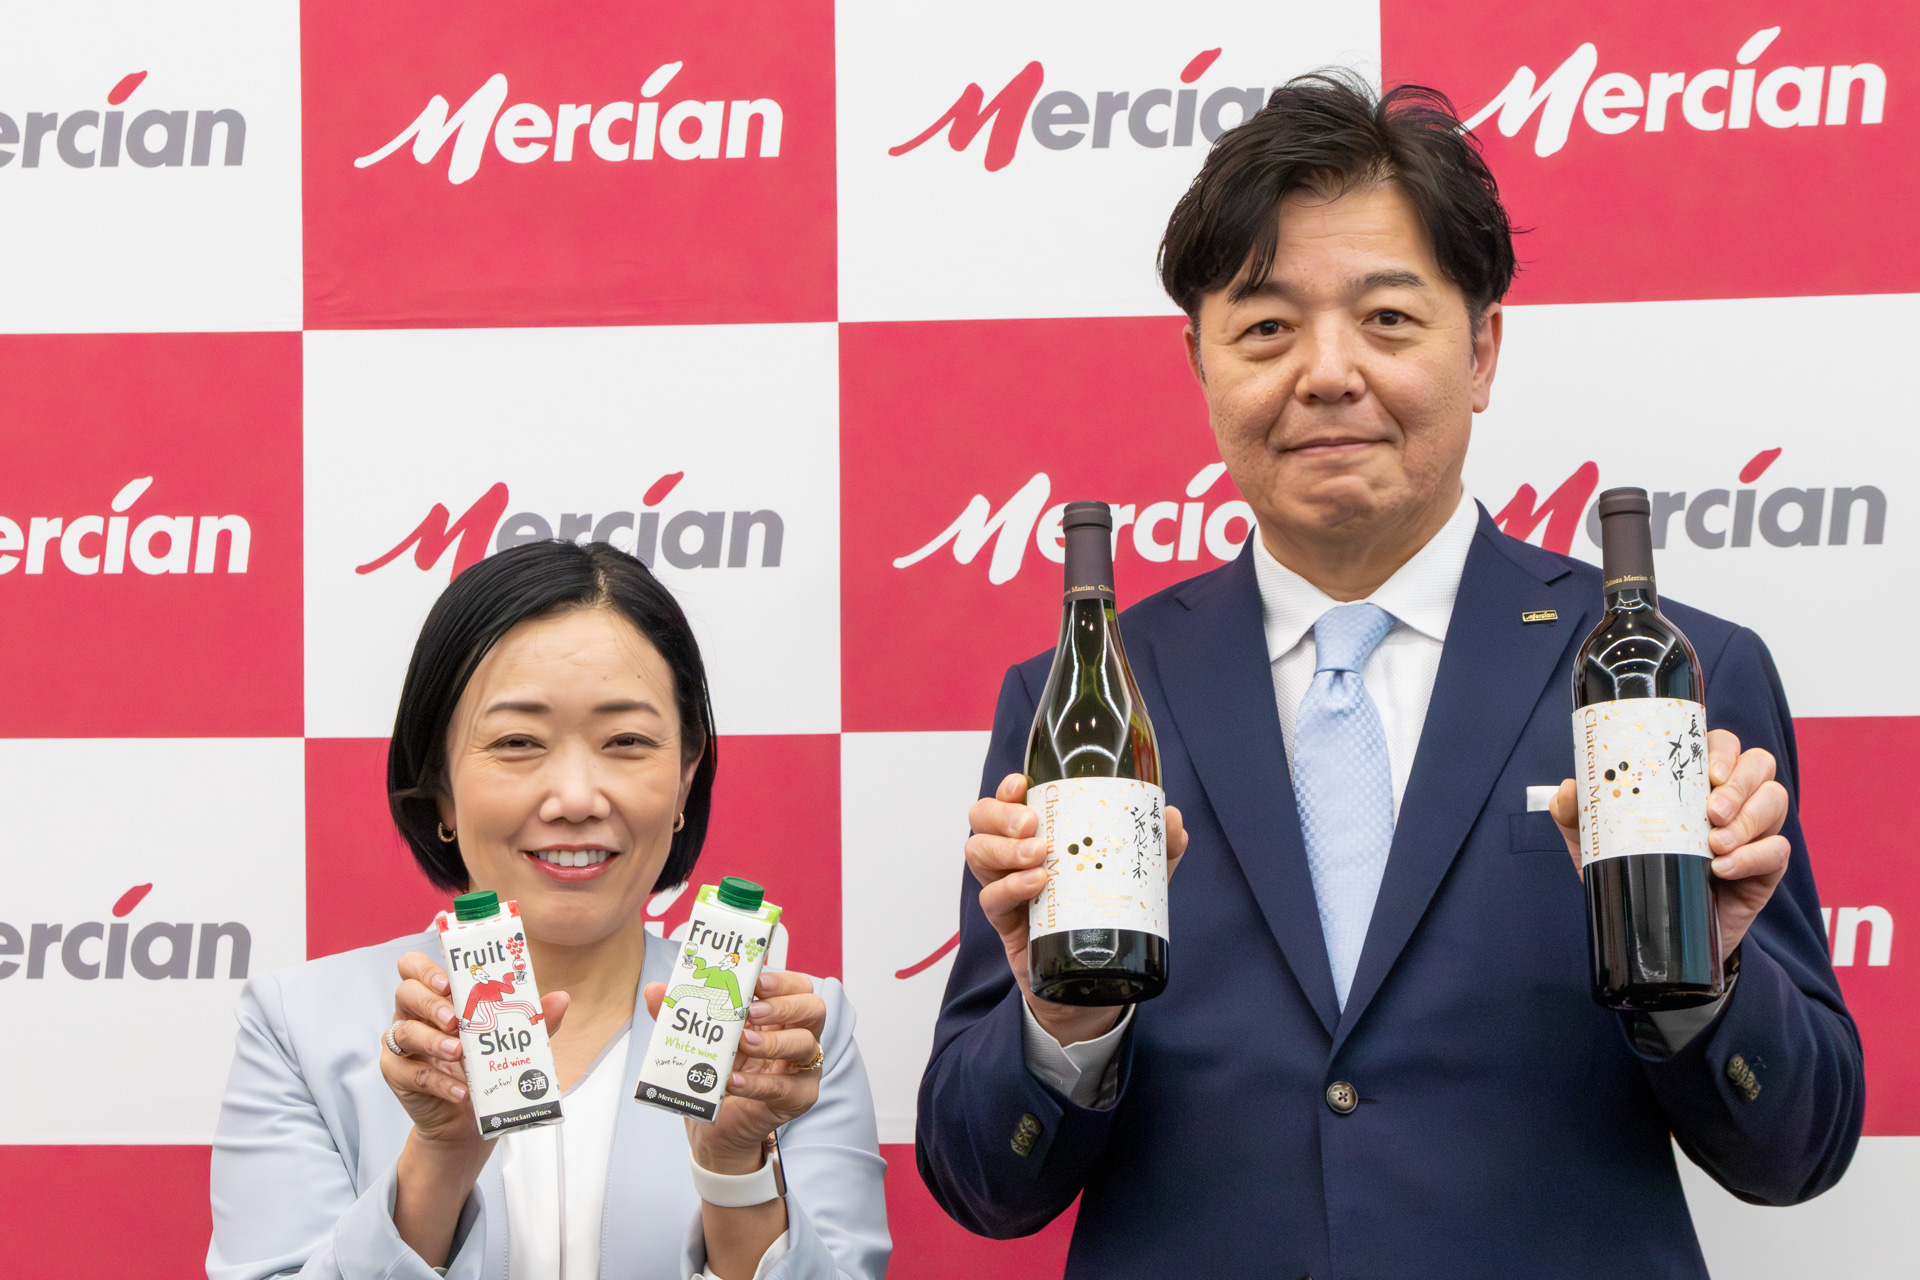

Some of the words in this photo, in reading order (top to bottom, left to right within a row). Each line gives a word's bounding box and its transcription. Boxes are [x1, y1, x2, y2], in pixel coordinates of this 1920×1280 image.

[888, 47, 1283, 172] Mercia
[1453, 26, 1887, 157] Mercian
[353, 61, 783, 185] Mercian
[1493, 447, 1887, 557] Mrcian
[1588, 783, 1601, 857] Mercian
[1046, 858, 1060, 929] Mercian
[688, 919, 744, 954] Fruit
[449, 940, 506, 971] Fruit
[478, 1027, 532, 1056] Skip
[671, 1007, 724, 1045] Skip
[489, 1057, 509, 1072] Red
[510, 1056, 532, 1067] wine
[665, 1036, 696, 1054] White
[698, 1048, 718, 1061] wine
[520, 1075, 547, 1093] お酒
[688, 1069, 716, 1088] お酒
